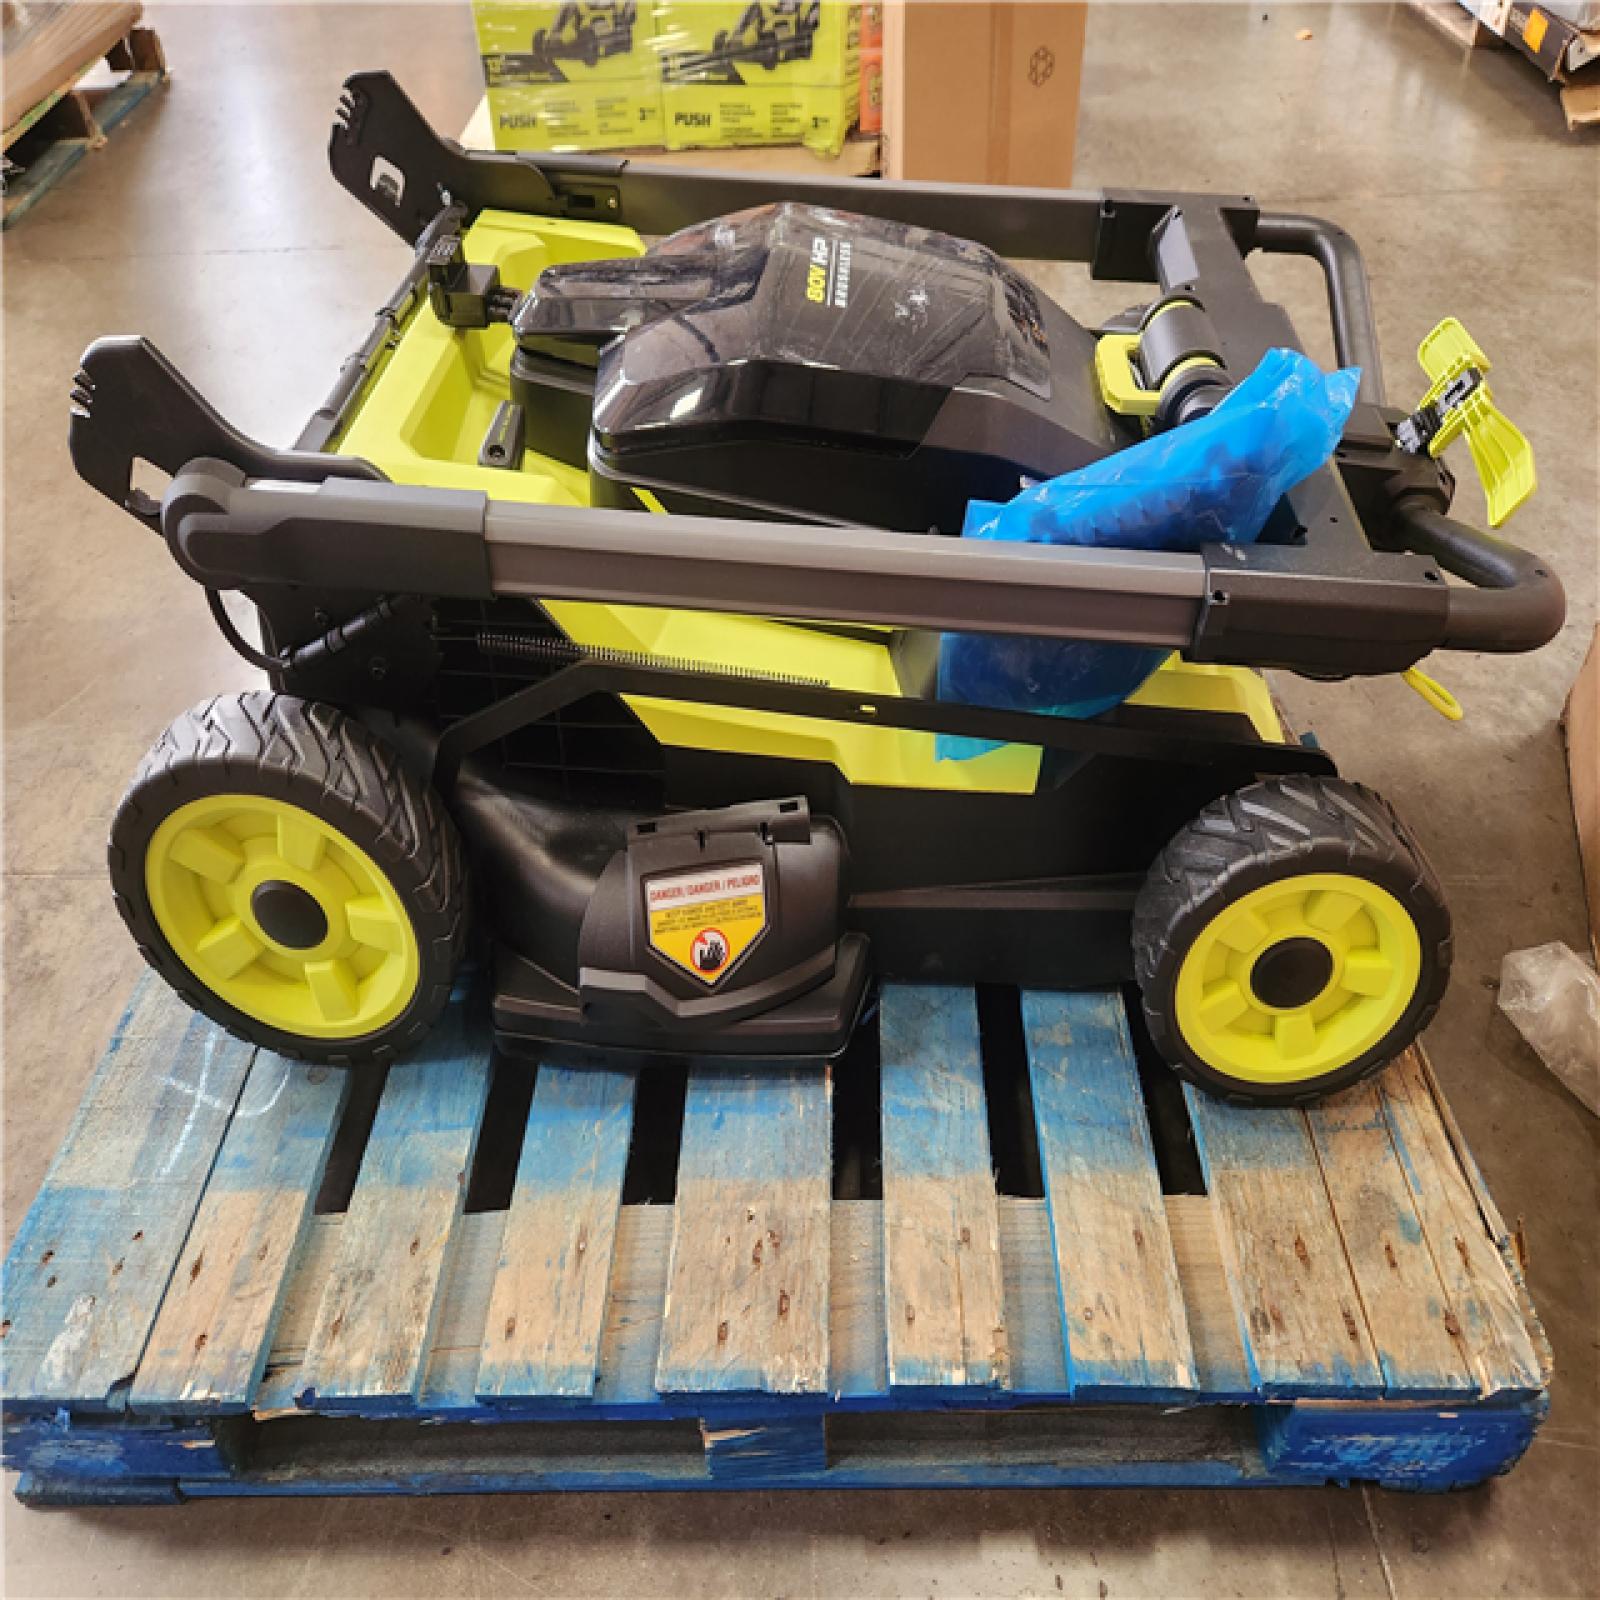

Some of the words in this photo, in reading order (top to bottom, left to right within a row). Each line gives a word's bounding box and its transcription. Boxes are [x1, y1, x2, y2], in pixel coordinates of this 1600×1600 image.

[499, 113, 537, 129] PUSH
[674, 112, 711, 127] PUSH
[811, 237, 828, 265] HP
[687, 880, 720, 895] DANGER
[727, 874, 760, 889] PELIGRO
